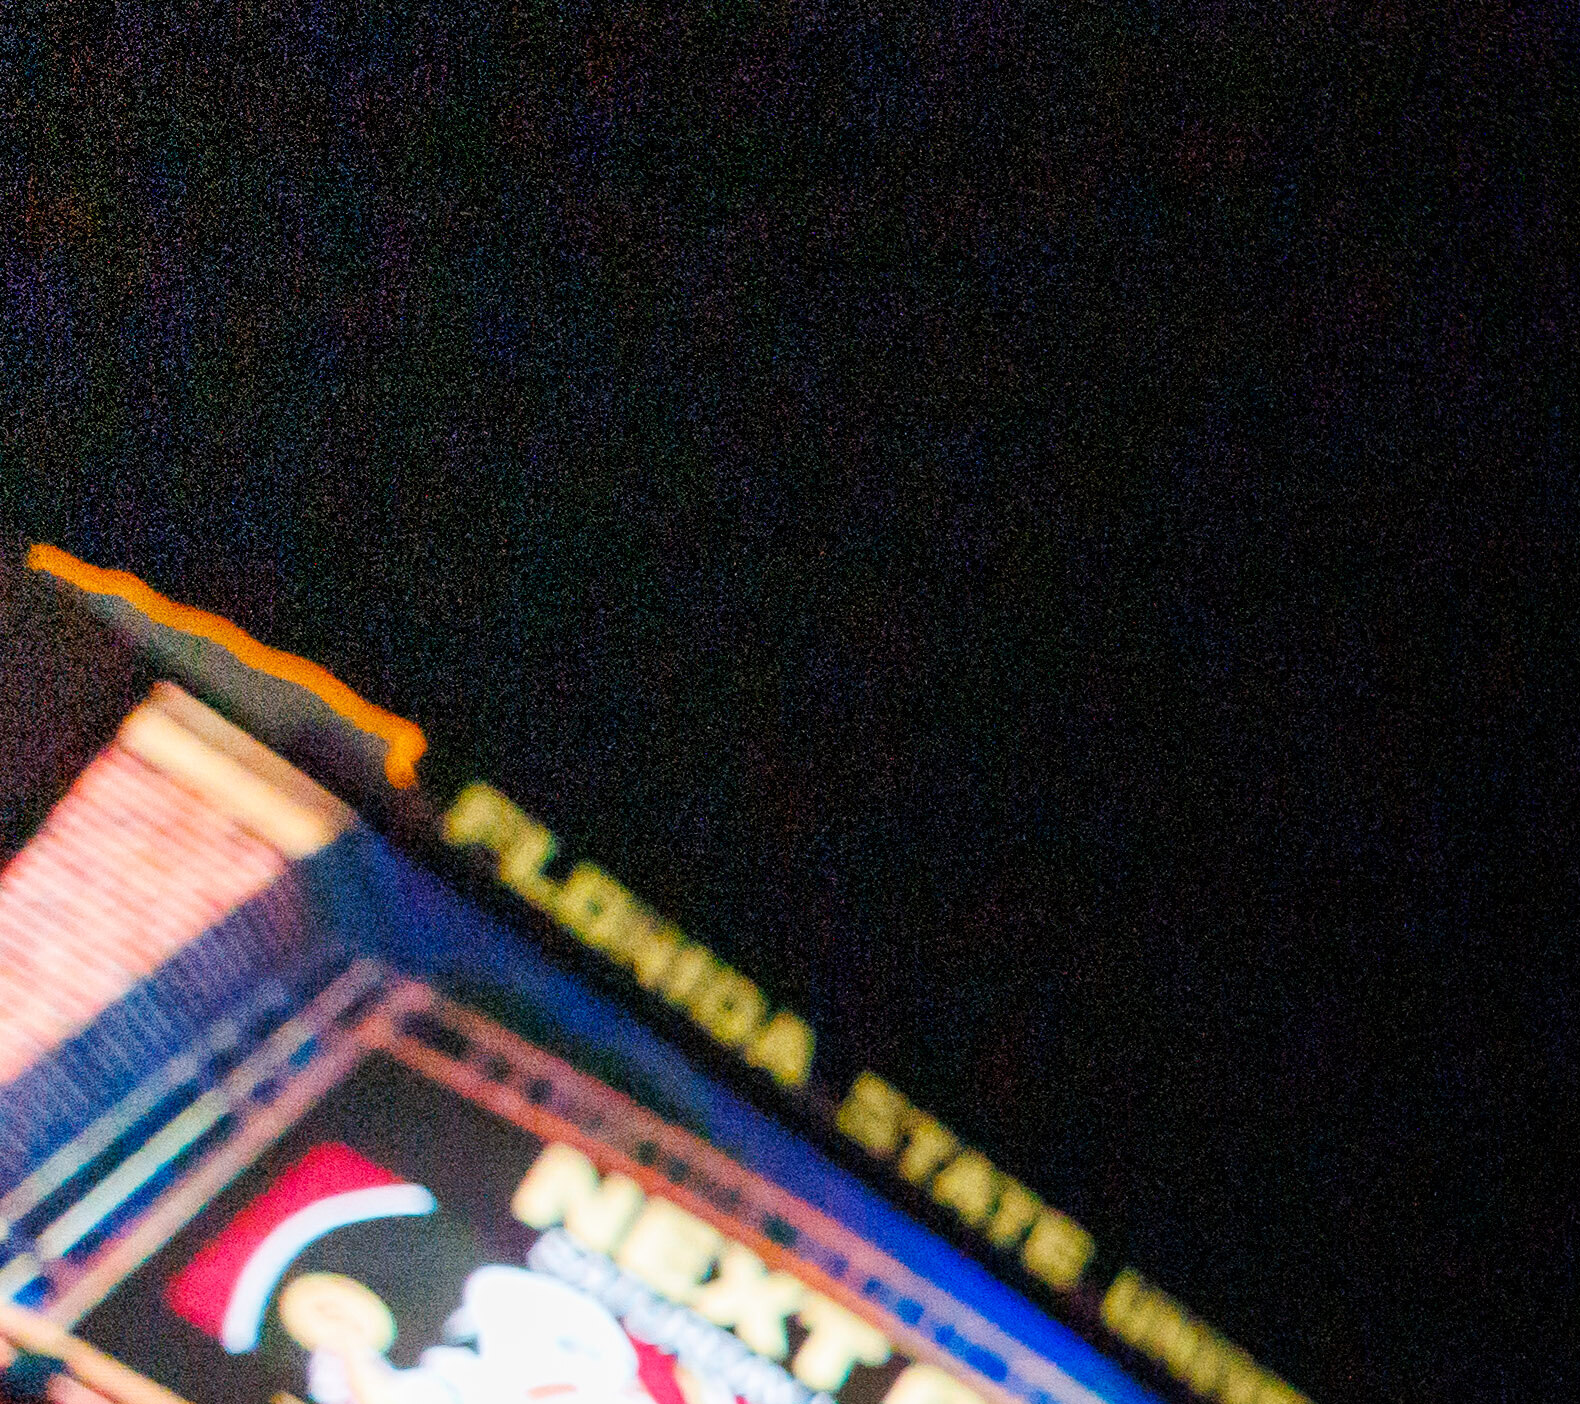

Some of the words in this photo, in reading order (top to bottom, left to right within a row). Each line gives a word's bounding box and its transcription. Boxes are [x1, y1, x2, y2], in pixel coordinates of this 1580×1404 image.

[444, 782, 815, 1087] FLORIDA
[836, 1069, 1097, 1291] STATE
[511, 1142, 892, 1391] NEXT
